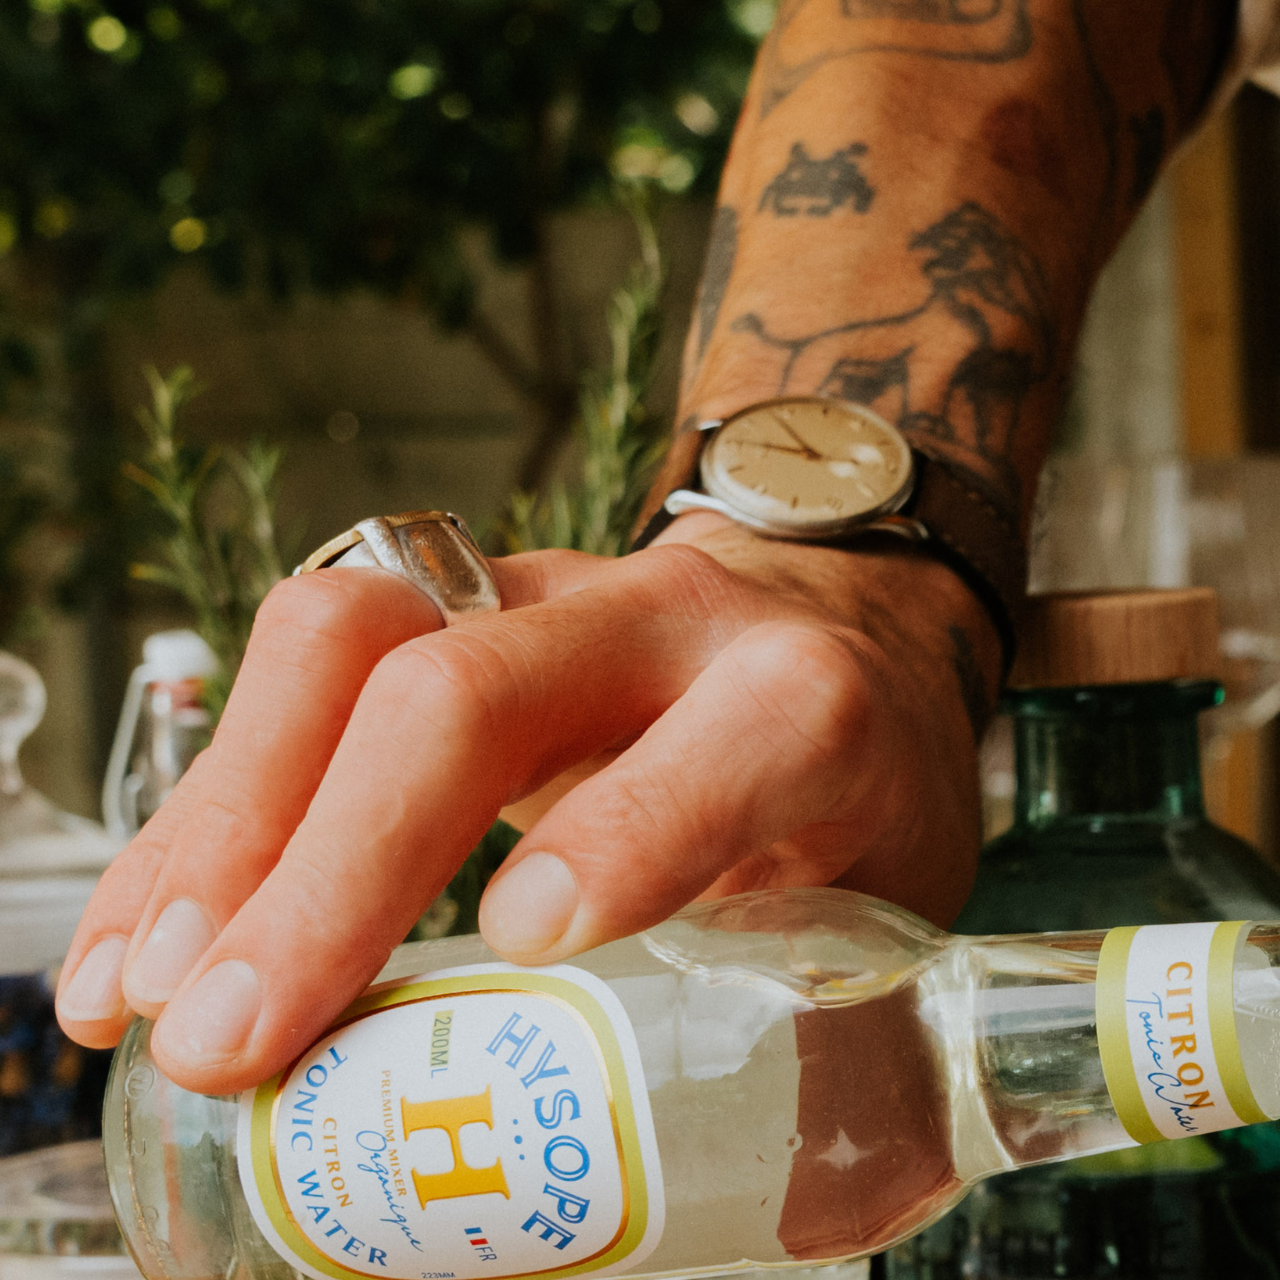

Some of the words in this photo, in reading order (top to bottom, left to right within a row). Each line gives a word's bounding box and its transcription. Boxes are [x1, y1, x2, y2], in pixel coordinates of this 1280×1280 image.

[430, 1016, 452, 1079] 200ML
[1126, 992, 1164, 1070] Tonic
[1147, 1072, 1199, 1132] Water
[1166, 961, 1215, 1111] CITRON
[292, 1046, 348, 1152] TONIC
[381, 1070, 396, 1143] PREMIUM
[400, 1083, 511, 1211] H
[486, 1012, 590, 1250] HYSOPE
[323, 1117, 353, 1208] CITRON
[355, 1130, 424, 1253] Organique
[388, 1149, 407, 1196] MIXER
[296, 1169, 388, 1267] WATER
[475, 1246, 497, 1262] FR
